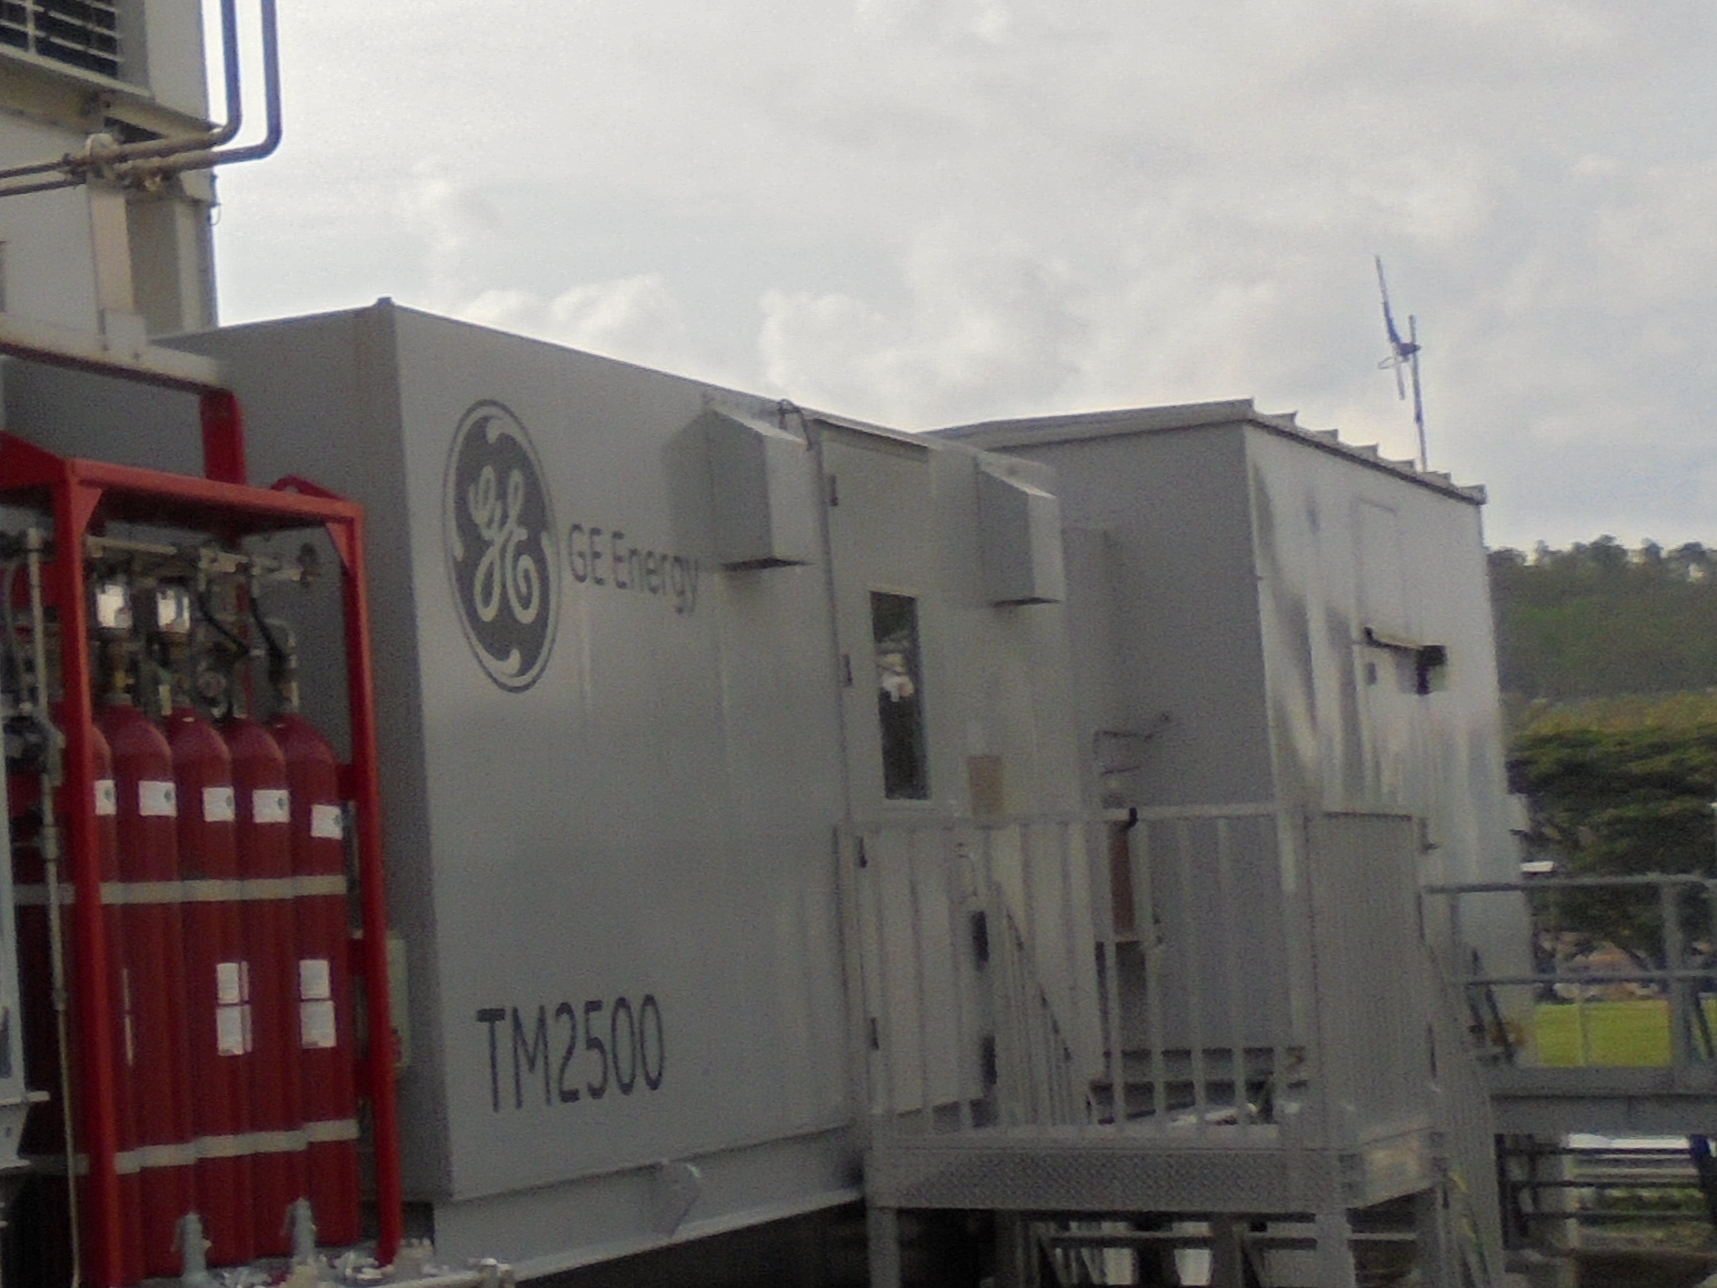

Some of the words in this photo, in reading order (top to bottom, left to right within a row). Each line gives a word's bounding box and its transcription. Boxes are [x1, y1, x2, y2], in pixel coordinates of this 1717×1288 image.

[568, 523, 606, 586] GE
[611, 530, 698, 616] Energy
[476, 993, 664, 1113] TM2500
